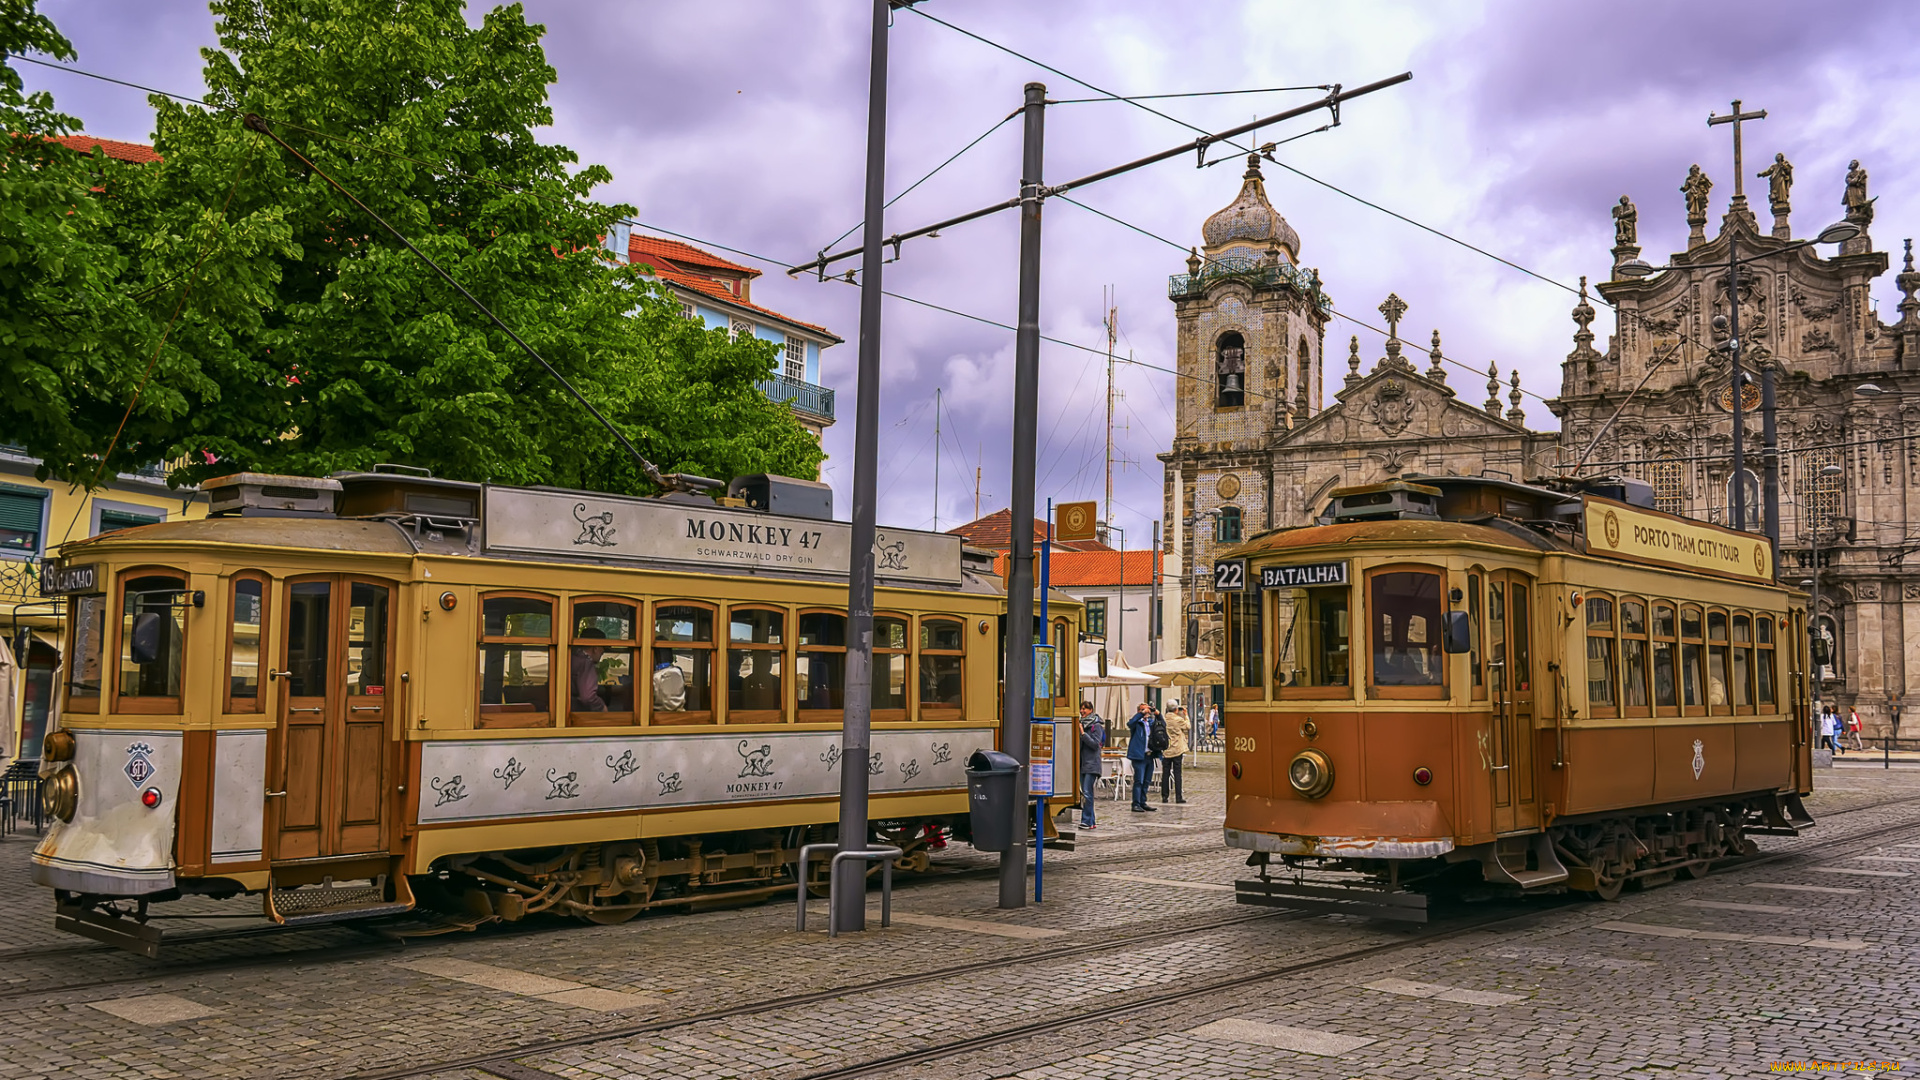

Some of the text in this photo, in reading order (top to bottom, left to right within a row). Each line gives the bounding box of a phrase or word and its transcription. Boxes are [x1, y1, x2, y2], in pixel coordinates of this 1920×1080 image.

[686, 518, 822, 549] MONKEY 47
[1634, 525, 1670, 548] PORTO
[1671, 532, 1696, 555] TRAM
[1697, 538, 1717, 558] CITY
[1718, 543, 1740, 563] TOUR
[697, 547, 813, 564] SCHWARZWALD DRY GIN
[43, 564, 54, 590] 18
[1216, 563, 1242, 588] 22
[1263, 565, 1340, 586] BATALHA
[1234, 736, 1256, 752] 220
[726, 781, 784, 793] MONKEY 47
